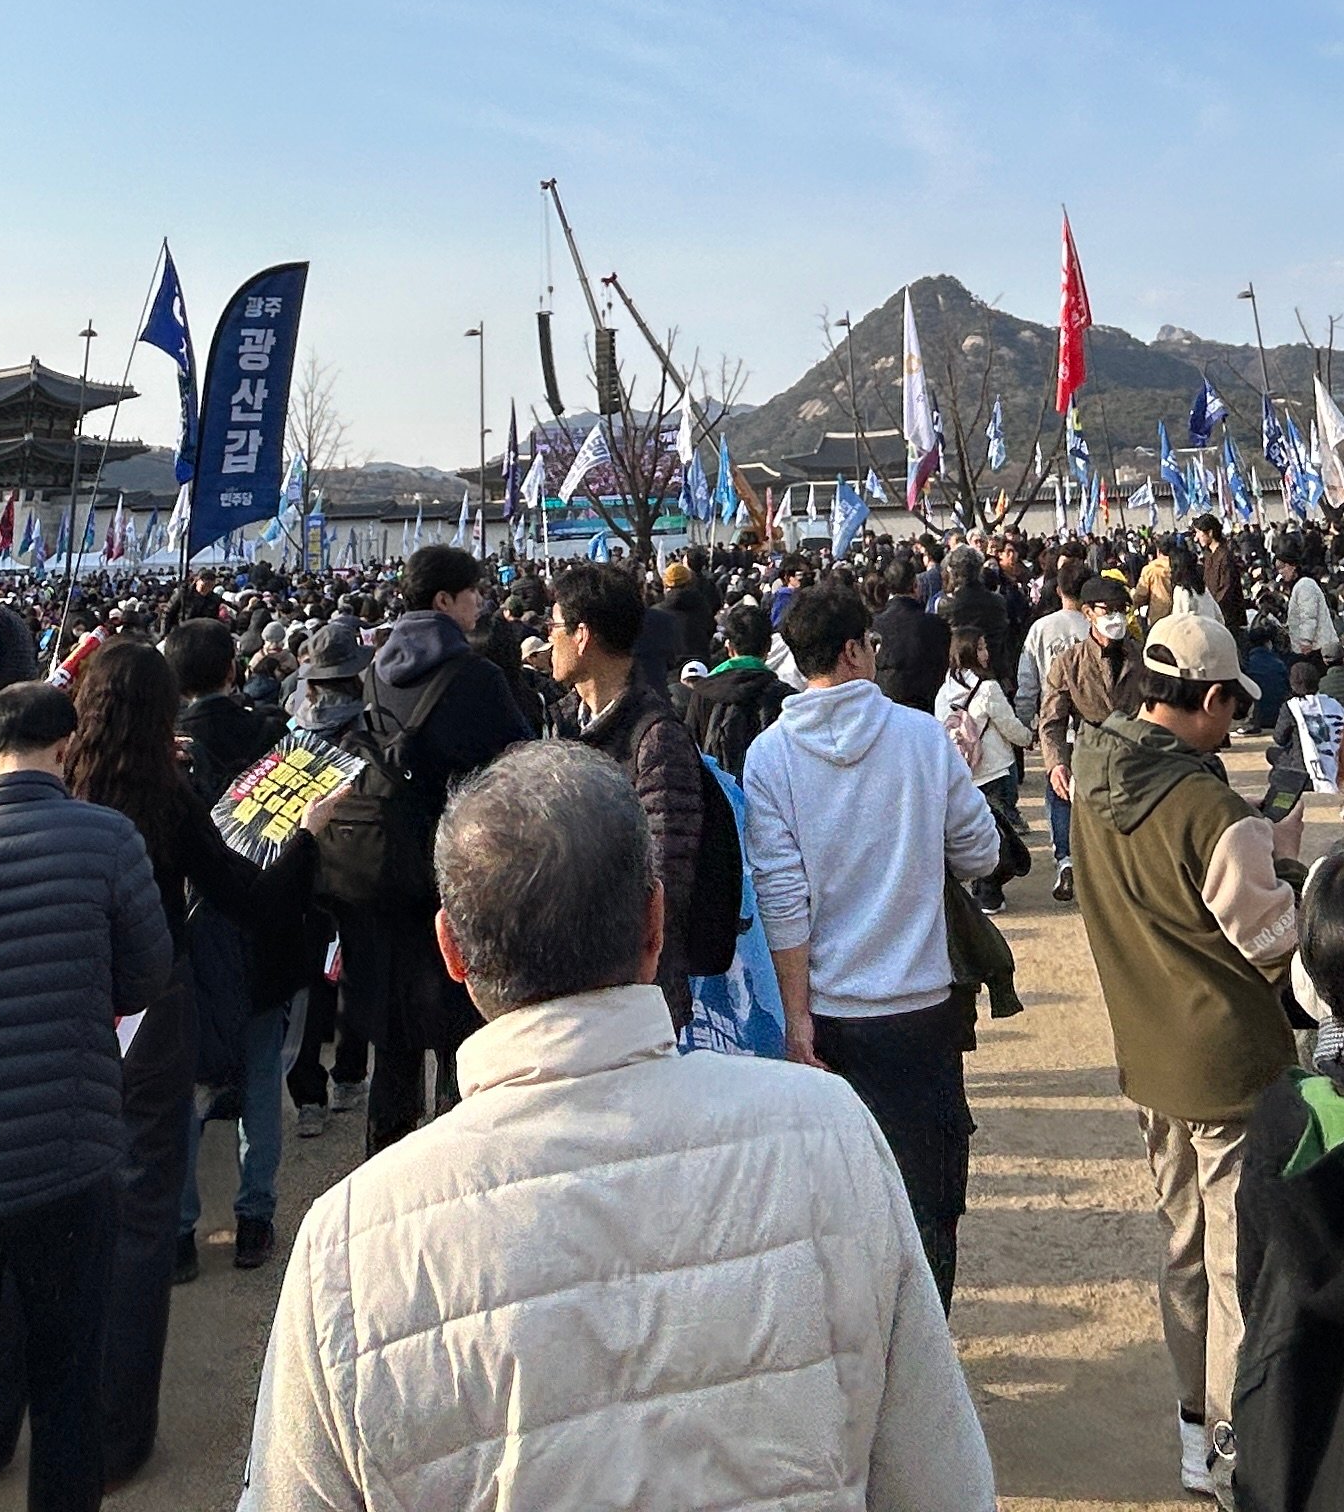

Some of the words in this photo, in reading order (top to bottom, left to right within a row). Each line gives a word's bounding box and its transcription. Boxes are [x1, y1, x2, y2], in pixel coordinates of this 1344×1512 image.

[244, 296, 282, 318] 광주
[221, 328, 277, 475] 광산갑
[219, 492, 253, 508] 민주당
